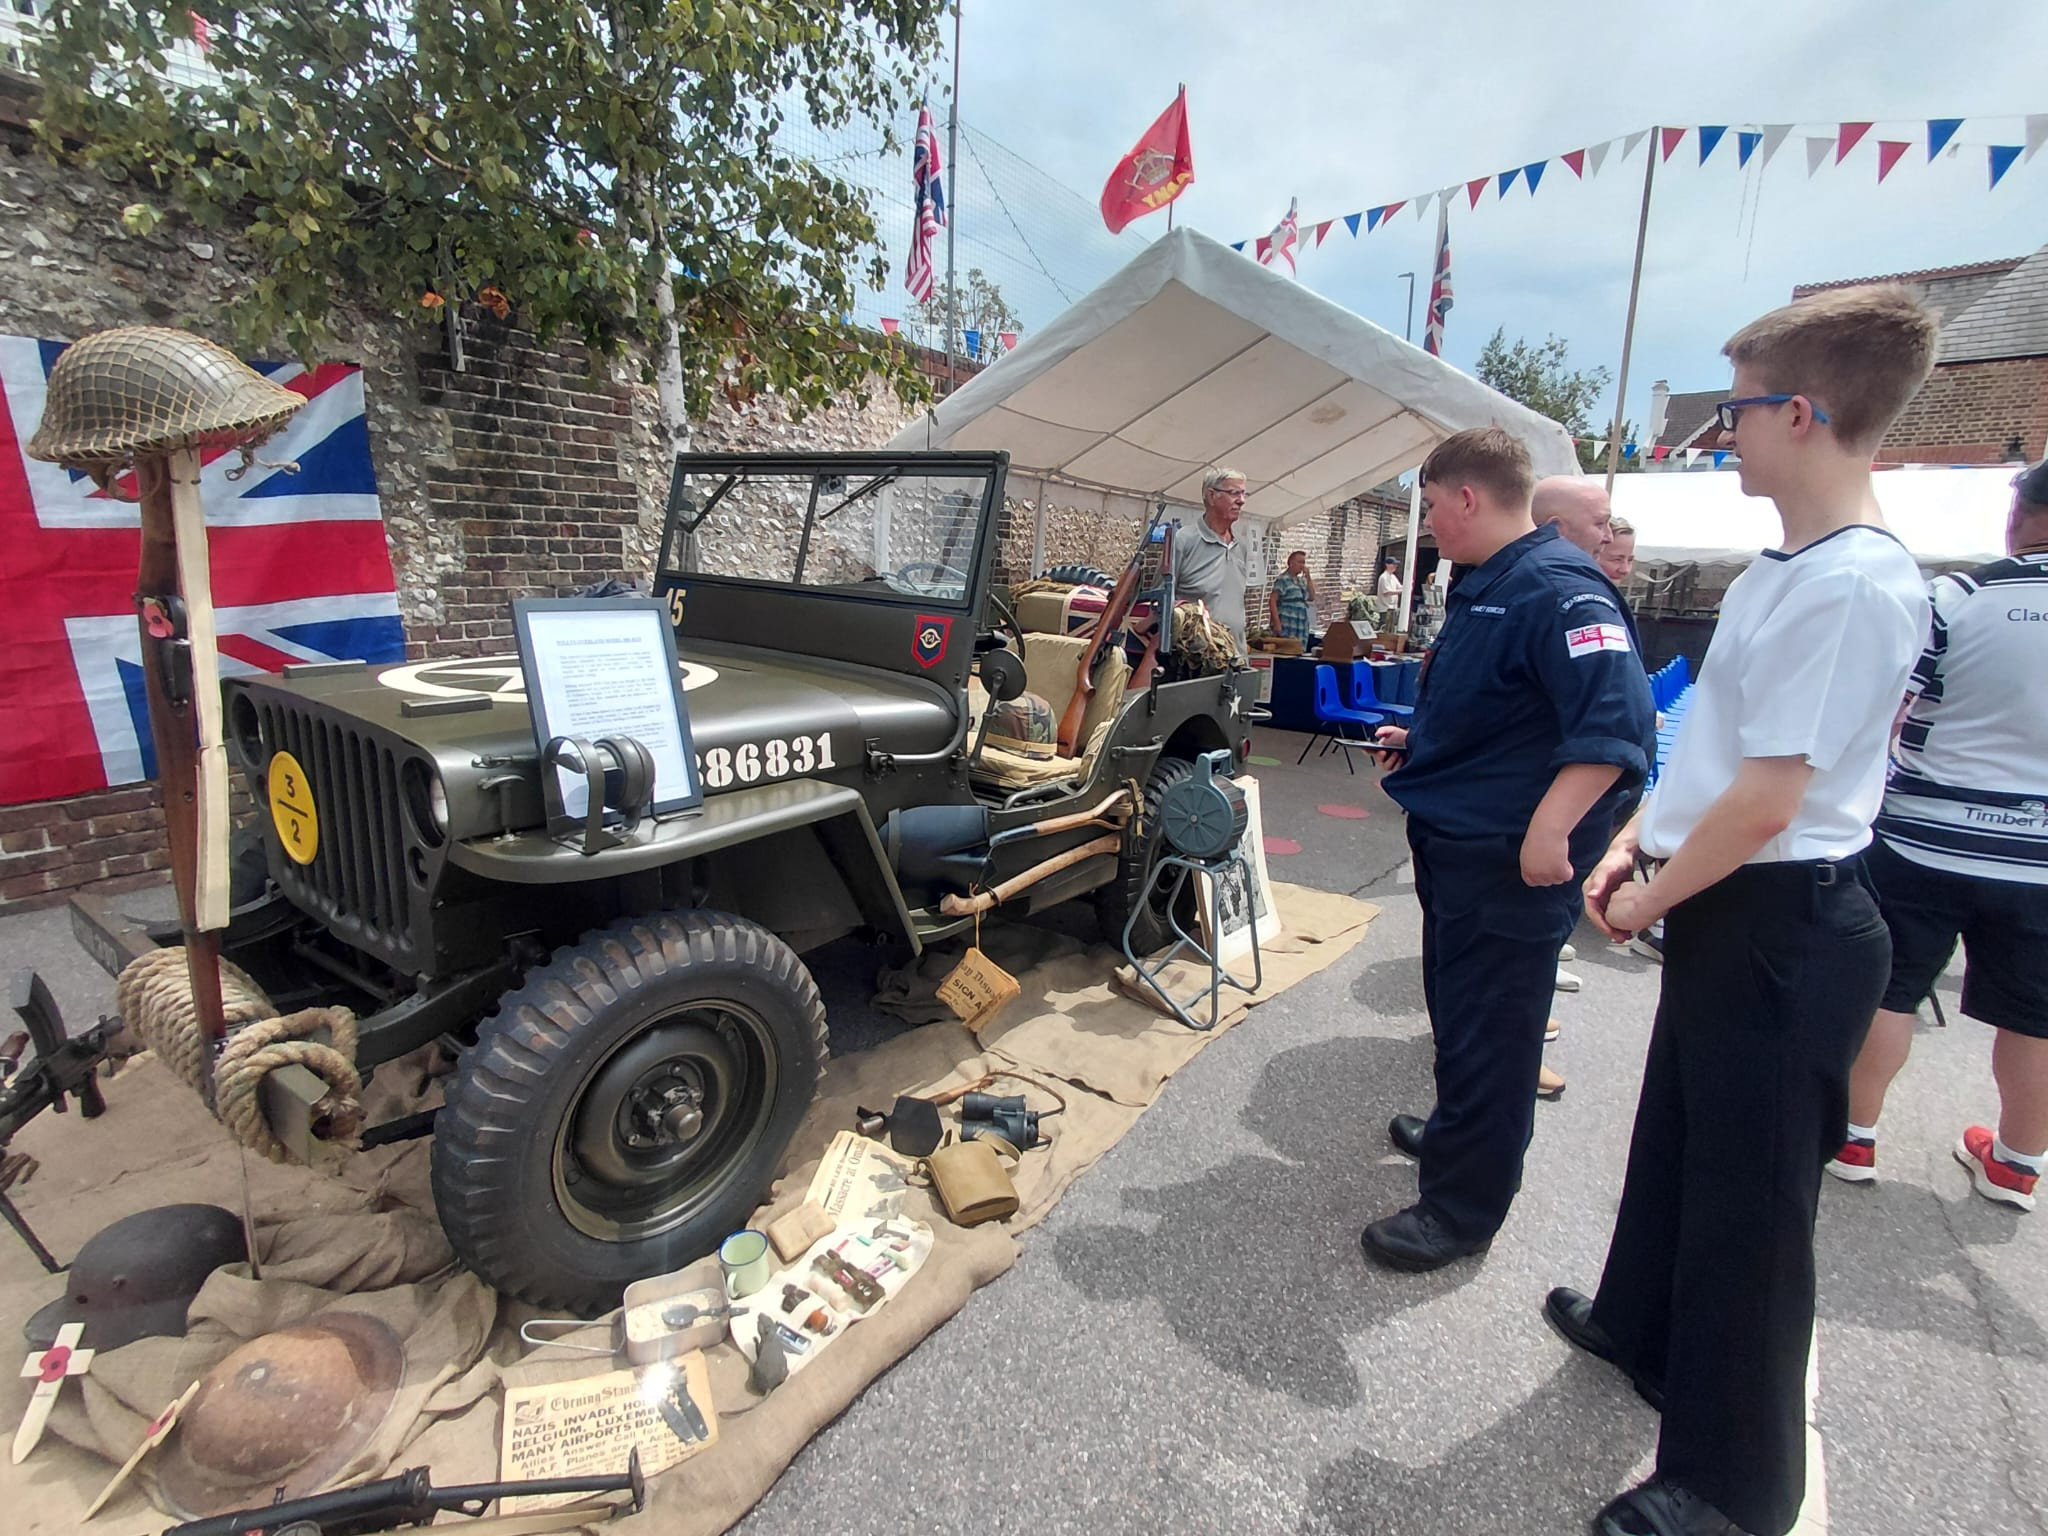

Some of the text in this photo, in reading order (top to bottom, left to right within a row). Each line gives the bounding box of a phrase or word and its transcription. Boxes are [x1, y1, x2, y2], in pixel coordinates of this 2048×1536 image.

[285, 773, 296, 798] 3
[1963, 806, 2037, 828] Timber
[291, 818, 302, 844] 2
[953, 978, 975, 1000] SIGN
[846, 1165, 857, 1178] at
[513, 1421, 556, 1439] NAZIS
[563, 1405, 616, 1427] INVADE
[511, 1441, 556, 1464] MANY
[560, 1421, 632, 1449] AIRPORTS
